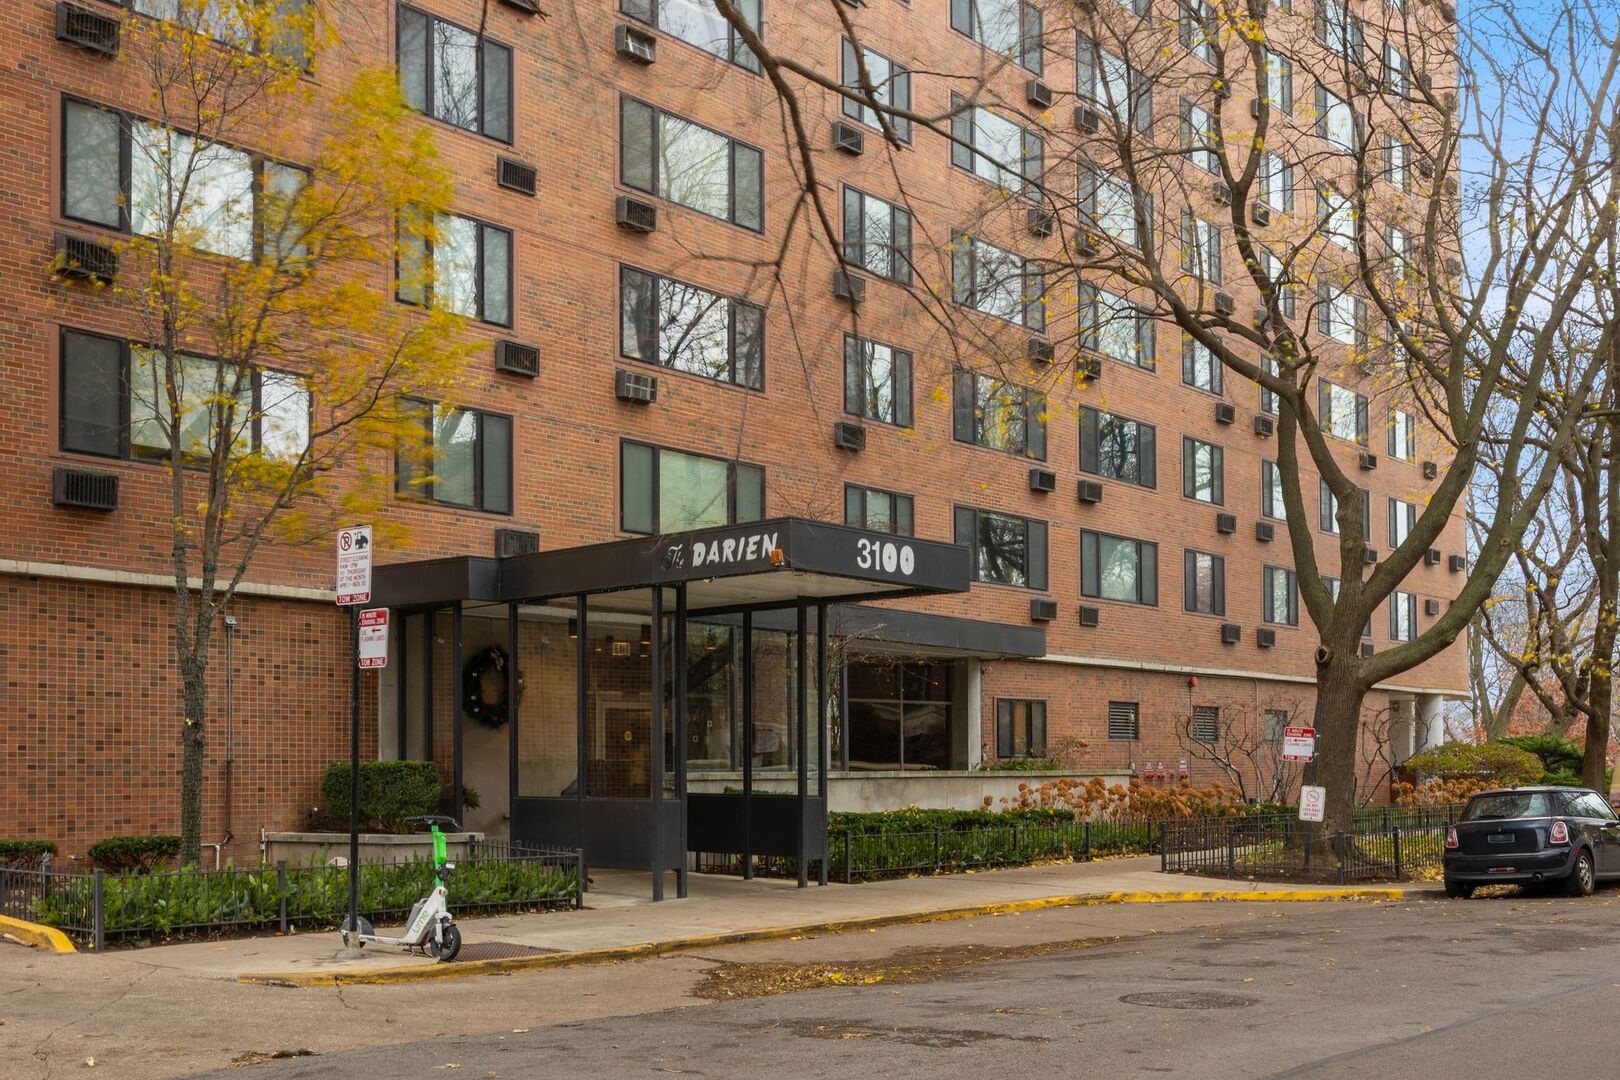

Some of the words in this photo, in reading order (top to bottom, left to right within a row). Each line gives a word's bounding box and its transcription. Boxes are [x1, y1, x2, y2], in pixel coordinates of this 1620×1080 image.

[691, 532, 778, 568] DARIEN
[856, 538, 915, 576] 3100
[339, 595, 351, 603] TOW
[352, 593, 368, 602] ZONE
[360, 657, 371, 666] TOW
[371, 656, 385, 666] ZONE
